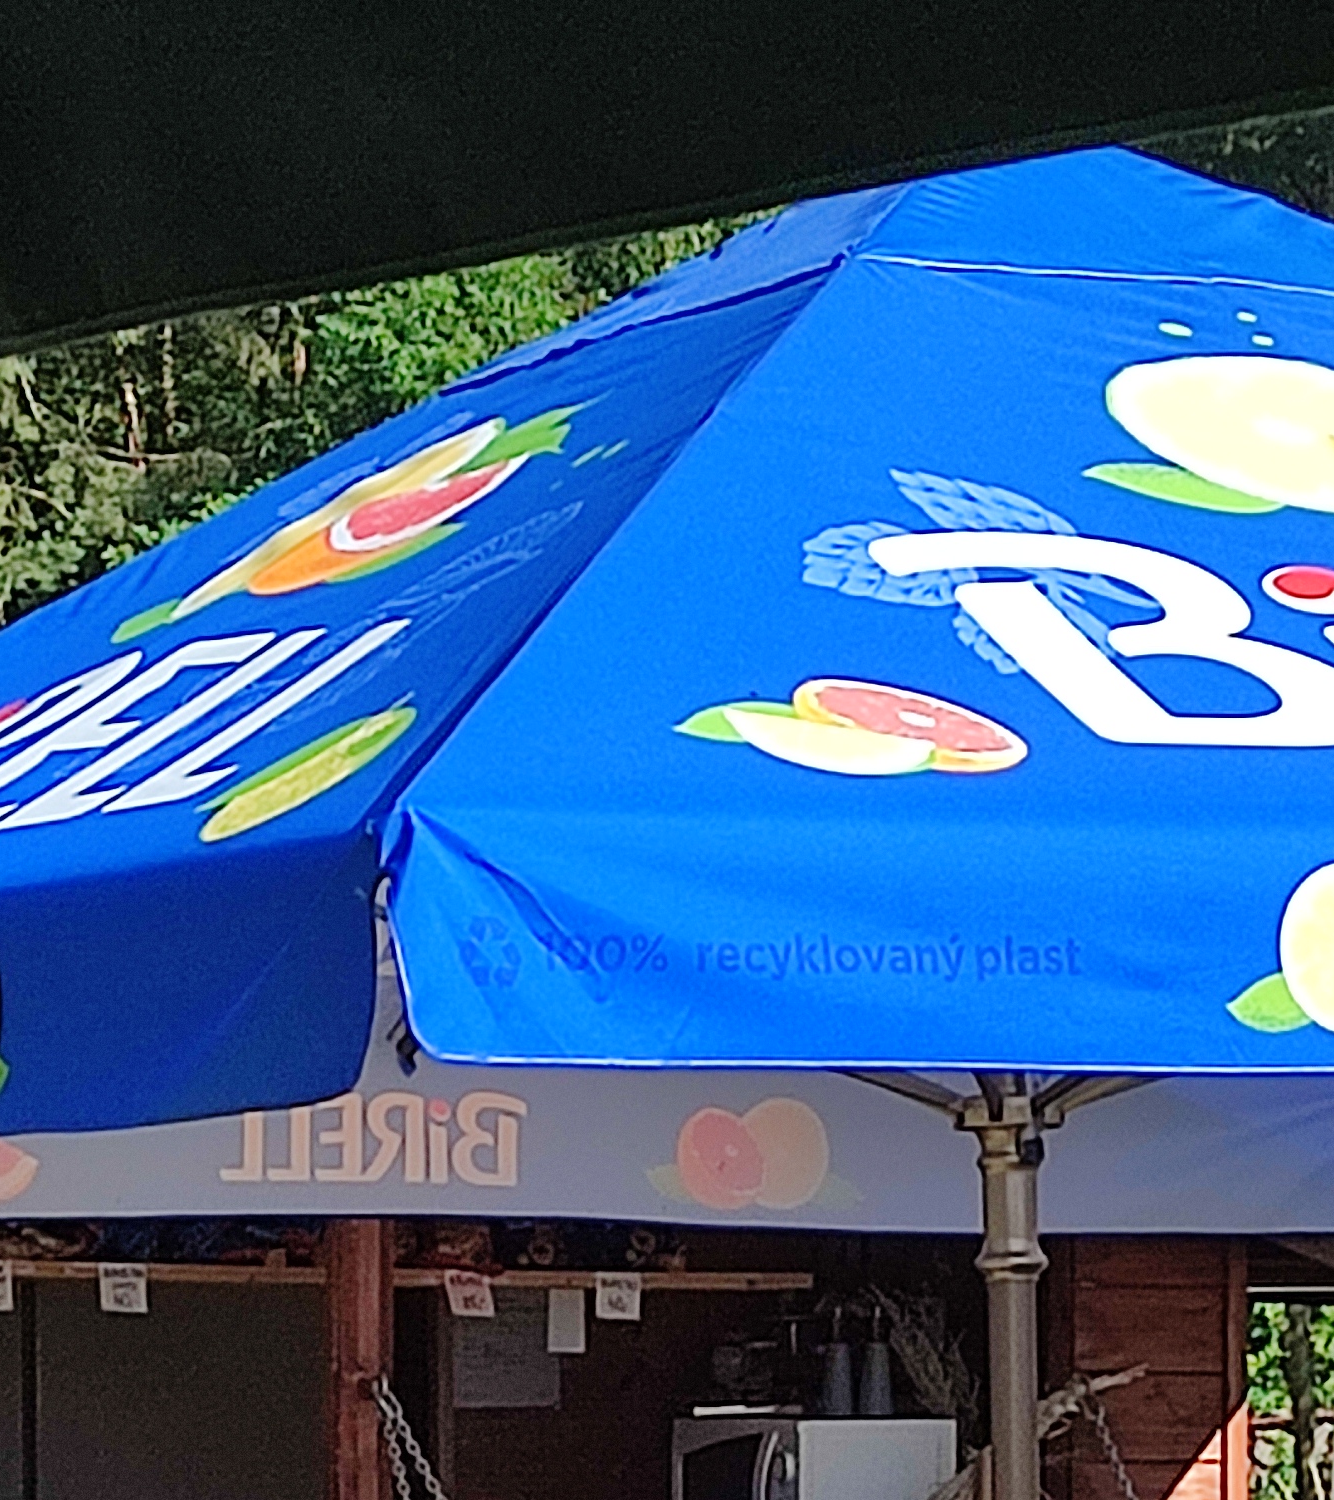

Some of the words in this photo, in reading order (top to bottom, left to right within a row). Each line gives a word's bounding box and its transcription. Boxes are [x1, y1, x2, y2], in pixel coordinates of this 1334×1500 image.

[545, 933, 667, 973] 100%
[696, 933, 964, 983] recyklovaný
[975, 935, 1082, 981] plast
